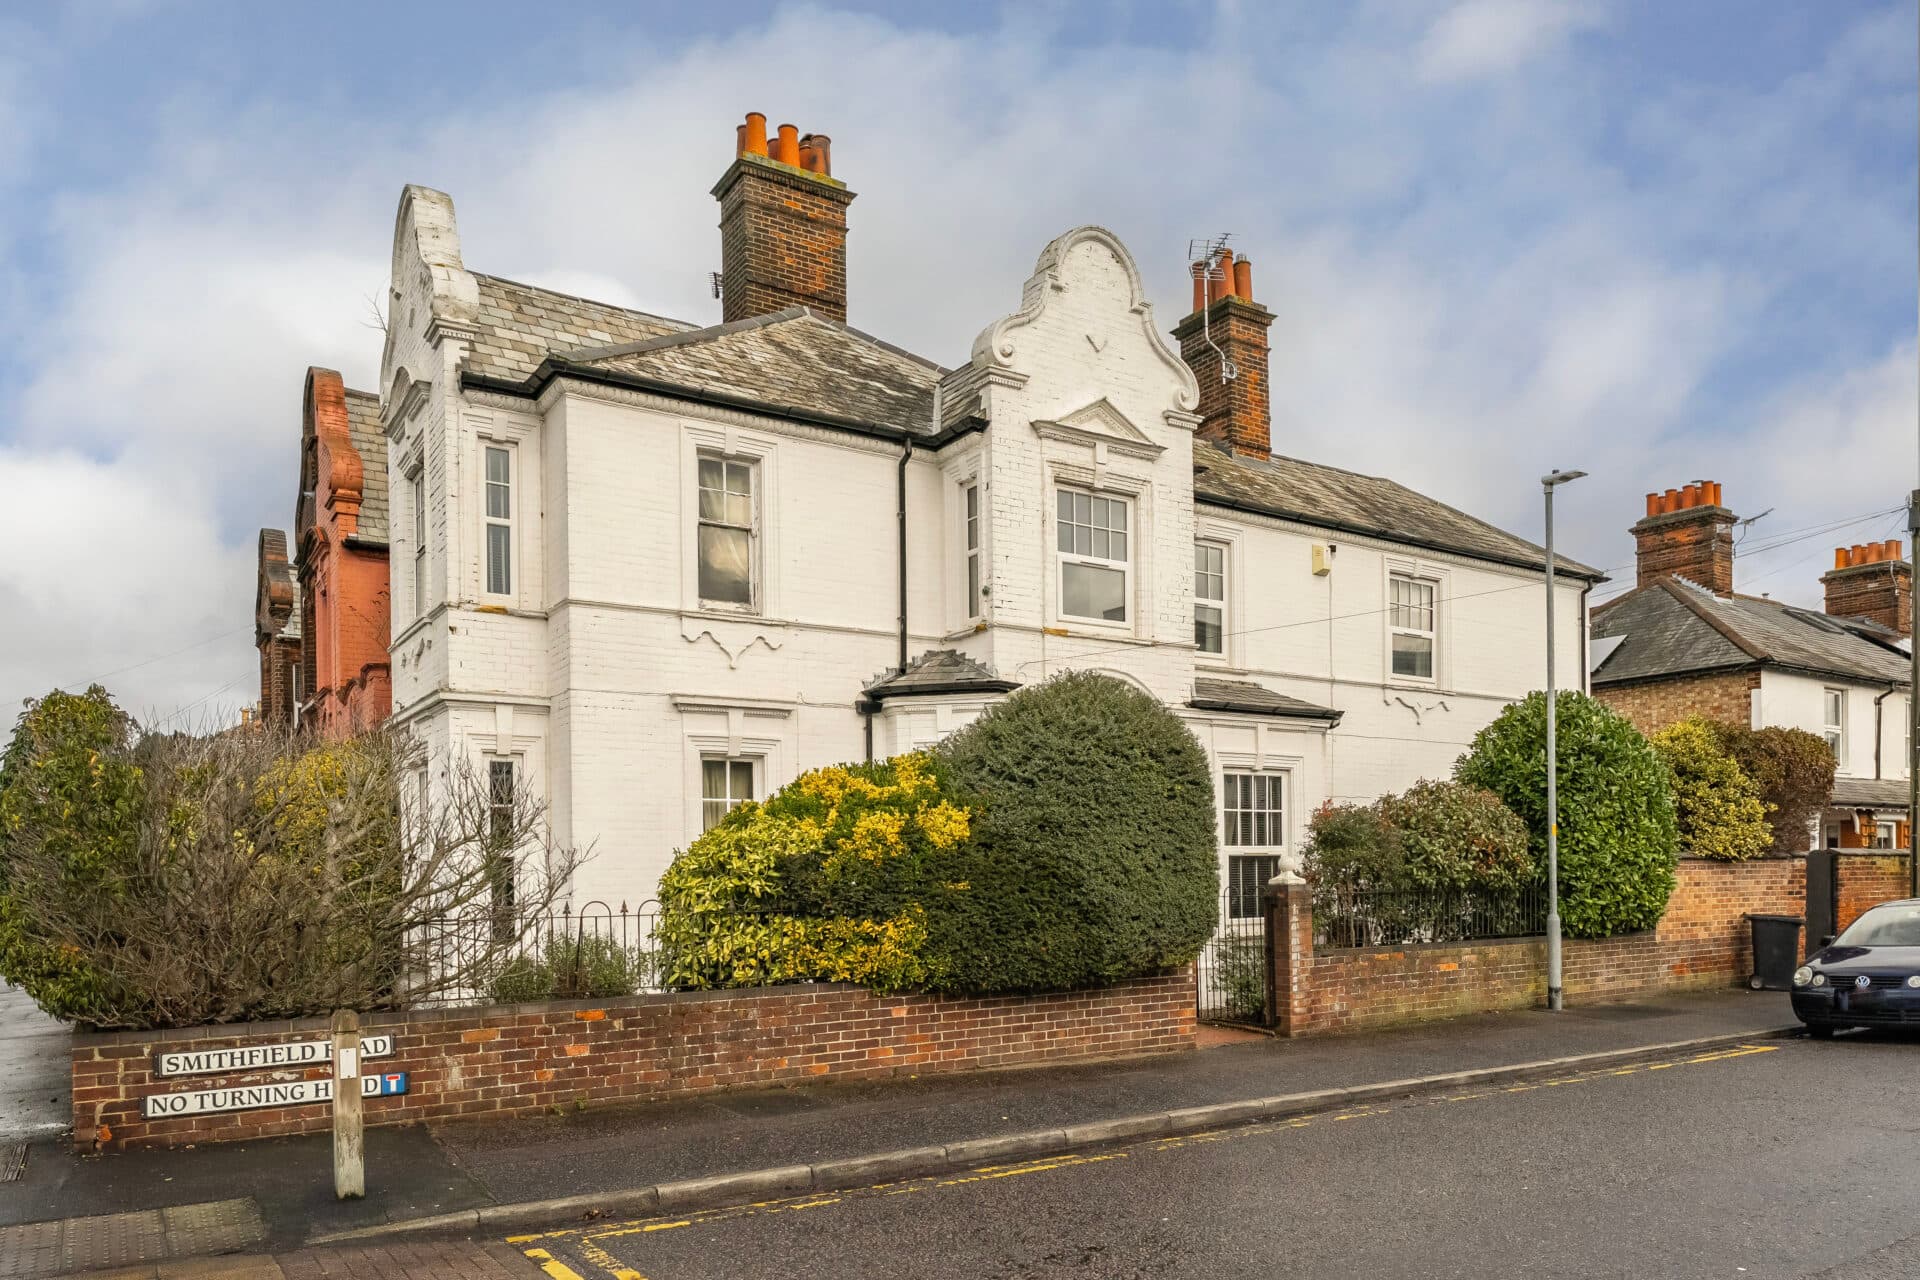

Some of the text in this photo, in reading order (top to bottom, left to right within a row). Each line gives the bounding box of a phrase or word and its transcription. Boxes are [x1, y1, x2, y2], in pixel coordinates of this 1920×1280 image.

[166, 1038, 387, 1073] SMITHFIELD AD
[151, 1078, 378, 1114] NO TURNING HD
